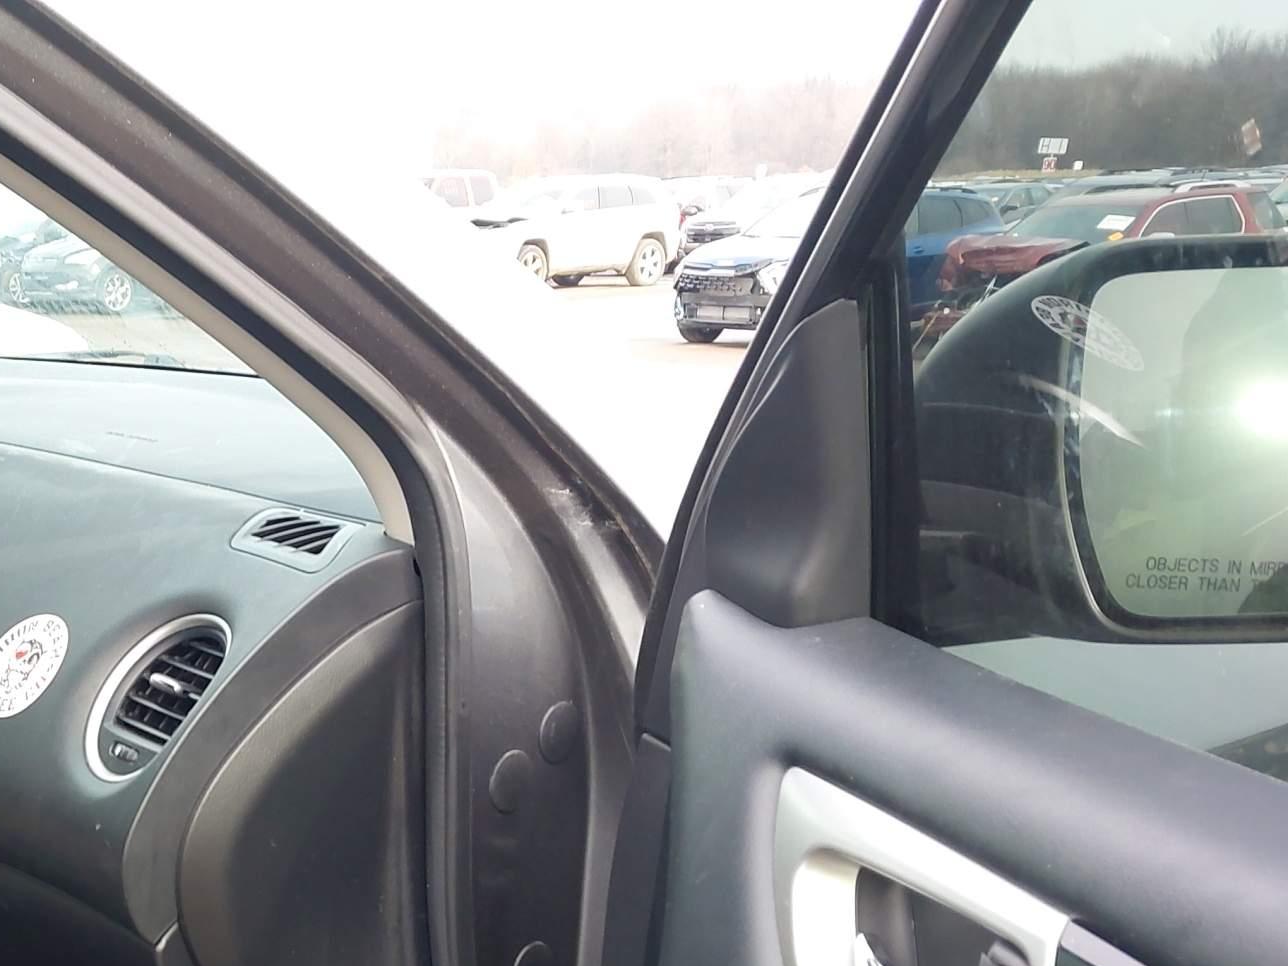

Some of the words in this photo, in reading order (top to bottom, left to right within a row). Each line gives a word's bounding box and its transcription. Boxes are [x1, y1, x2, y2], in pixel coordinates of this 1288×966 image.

[1145, 556, 1220, 574] OBJECTS
[1227, 558, 1242, 574] IN
[1125, 573, 1189, 591] CLOSER
[1198, 576, 1241, 593] THAN
